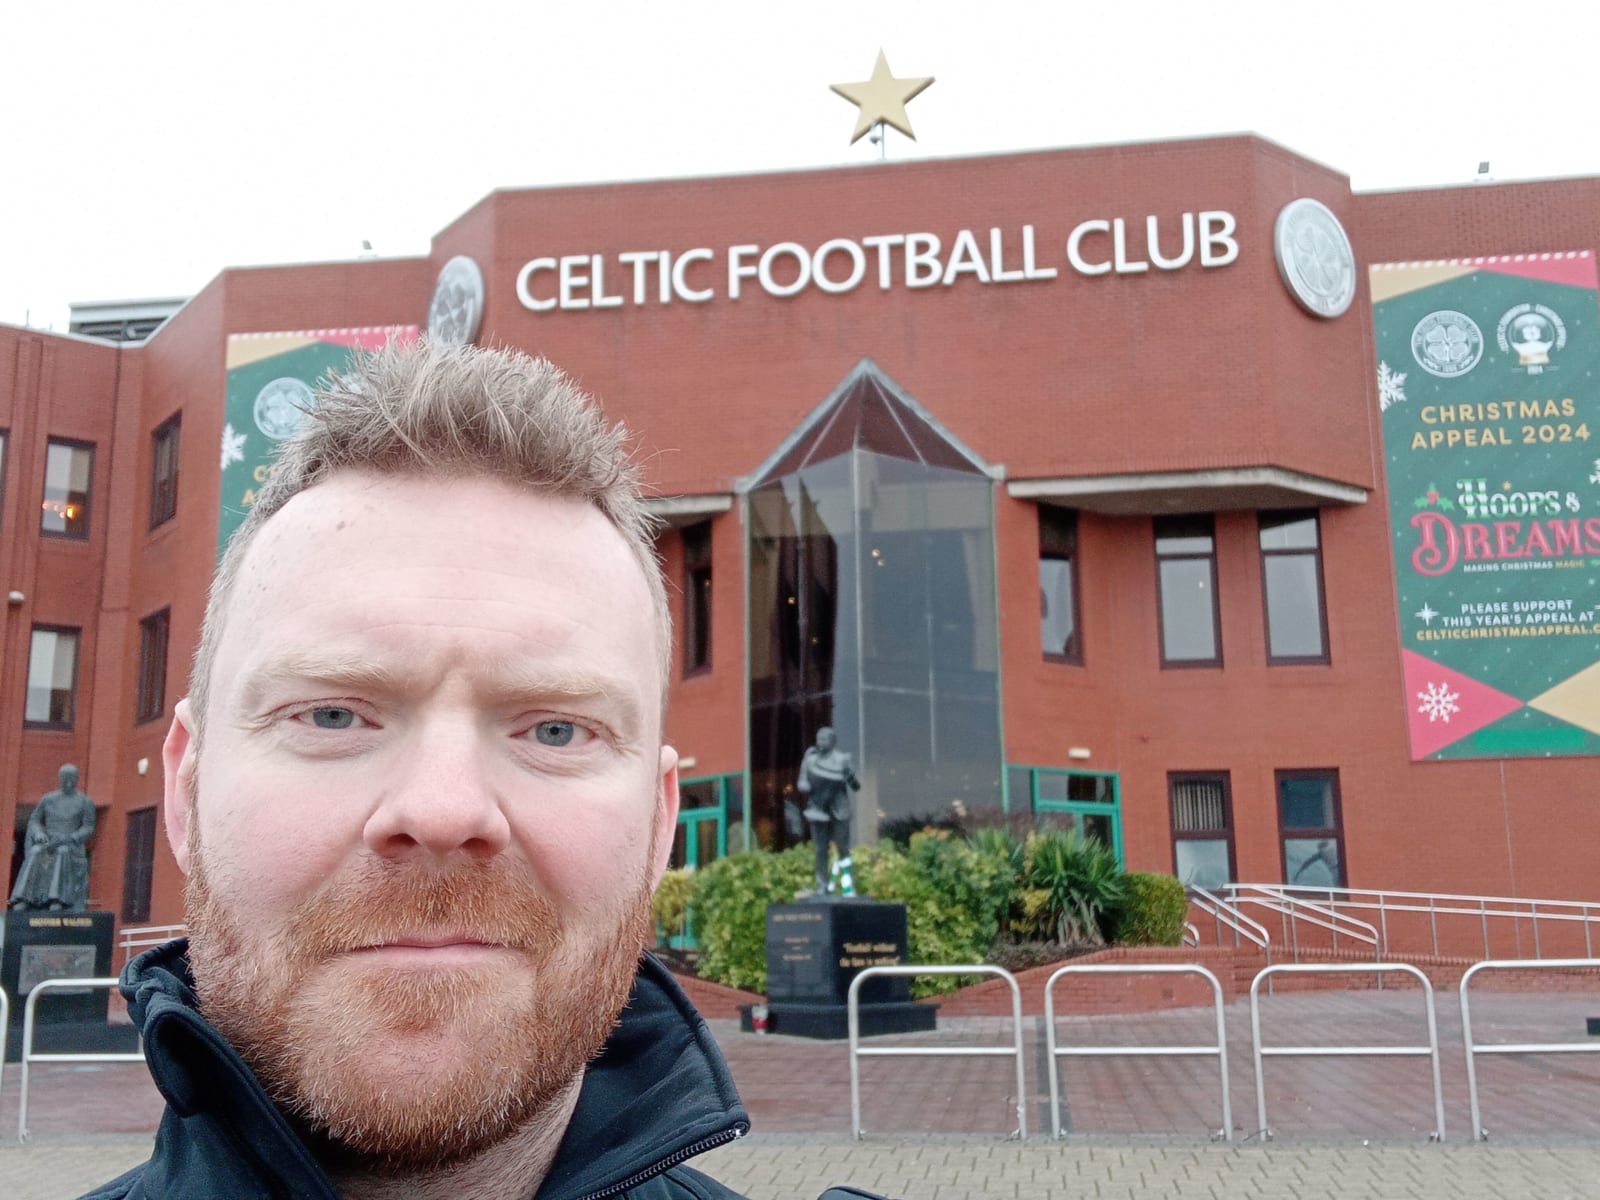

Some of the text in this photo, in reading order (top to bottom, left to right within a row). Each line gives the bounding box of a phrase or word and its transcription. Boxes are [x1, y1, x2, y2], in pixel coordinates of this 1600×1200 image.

[516, 210, 1240, 311] CELTIC FOOTBALL CLUB
[1420, 398, 1576, 424] CHRISTMAS
[1411, 424, 1590, 449] APPEAL 2024
[1456, 478, 1580, 519] HOOPS &
[1410, 511, 1600, 577] DREAMS
[1463, 562, 1500, 573] MAKING
[1501, 561, 1553, 571] CHRISTMAS
[1461, 599, 1573, 614] PLEASE SUPPORT
[1442, 611, 1595, 628] THIS YEAR'S APPEAL AT
